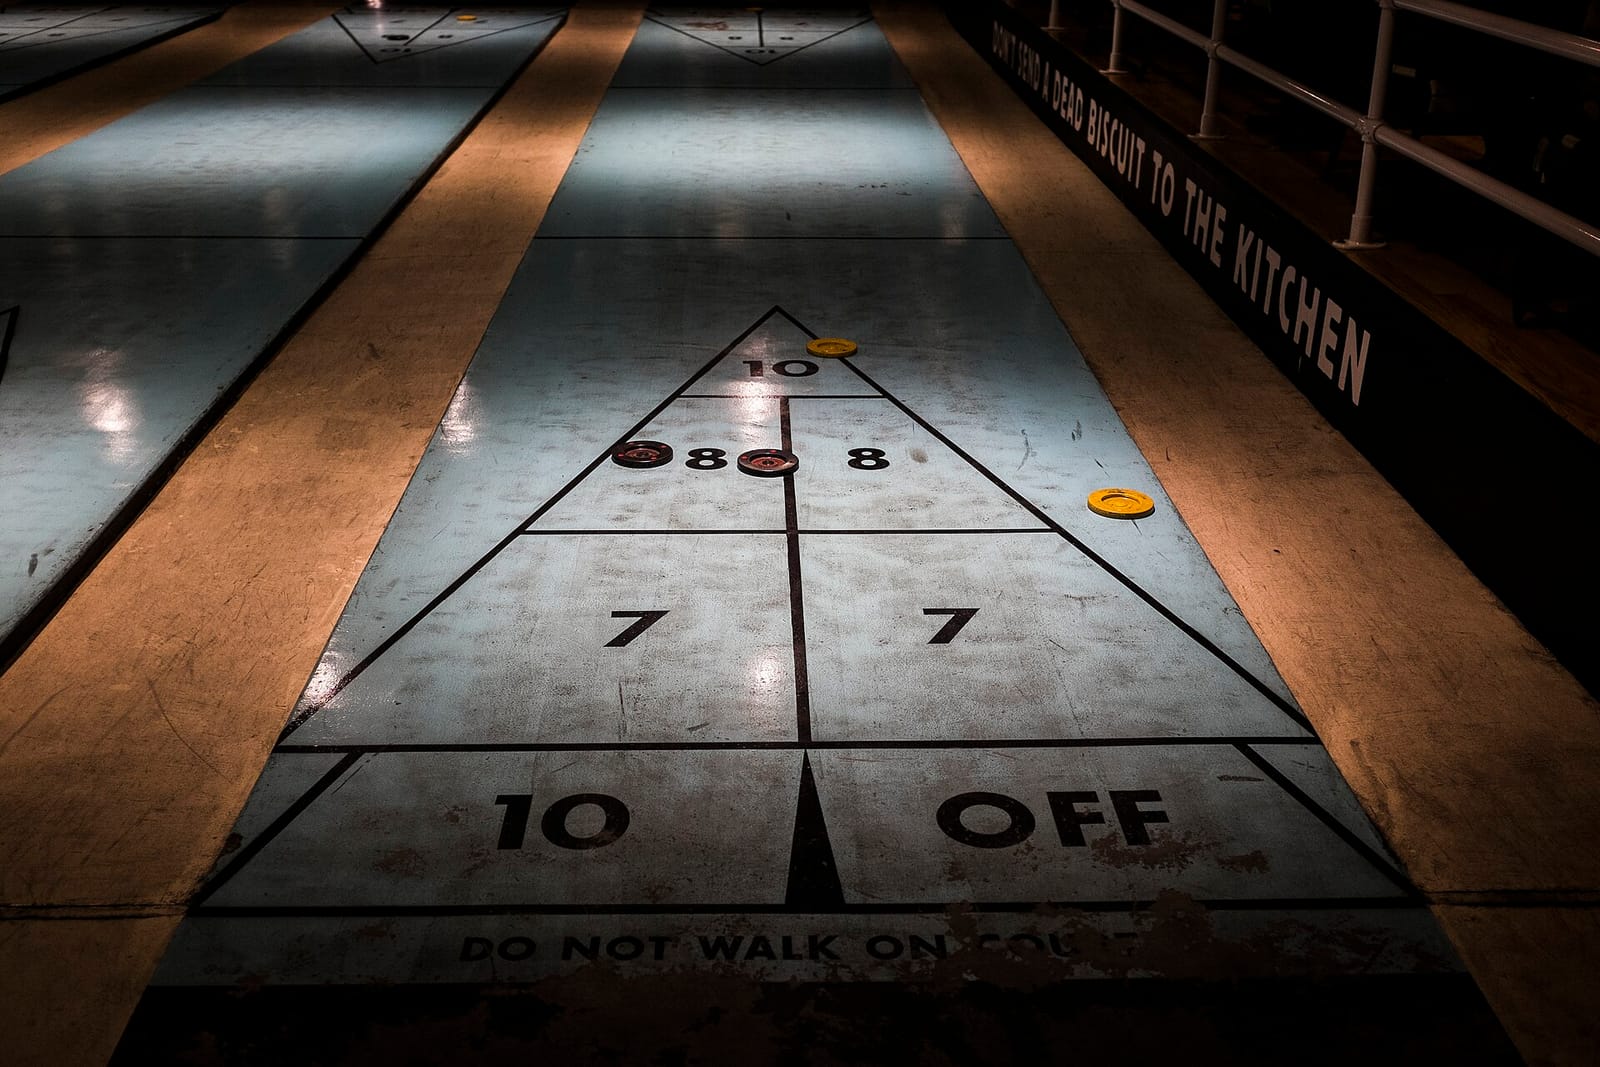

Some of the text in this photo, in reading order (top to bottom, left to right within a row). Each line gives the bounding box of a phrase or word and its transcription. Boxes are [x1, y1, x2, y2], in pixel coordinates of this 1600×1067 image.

[1017, 40, 1041, 92] SEND
[1042, 60, 1050, 103] A
[1052, 69, 1084, 132] DEAD
[1087, 98, 1147, 191] BISCUIT
[1152, 150, 1176, 217] TO
[1183, 176, 1230, 269] THE
[1232, 223, 1372, 408] KITCHEN
[743, 360, 819, 377] 10
[685, 448, 728, 470] 8
[848, 448, 890, 470] 8
[603, 610, 670, 648] 7
[923, 608, 980, 644] 7
[494, 790, 1171, 850] 10 OFF
[459, 936, 537, 962] DO
[561, 936, 673, 961] NOT
[697, 935, 841, 961] WALK
[865, 934, 949, 961] ON
